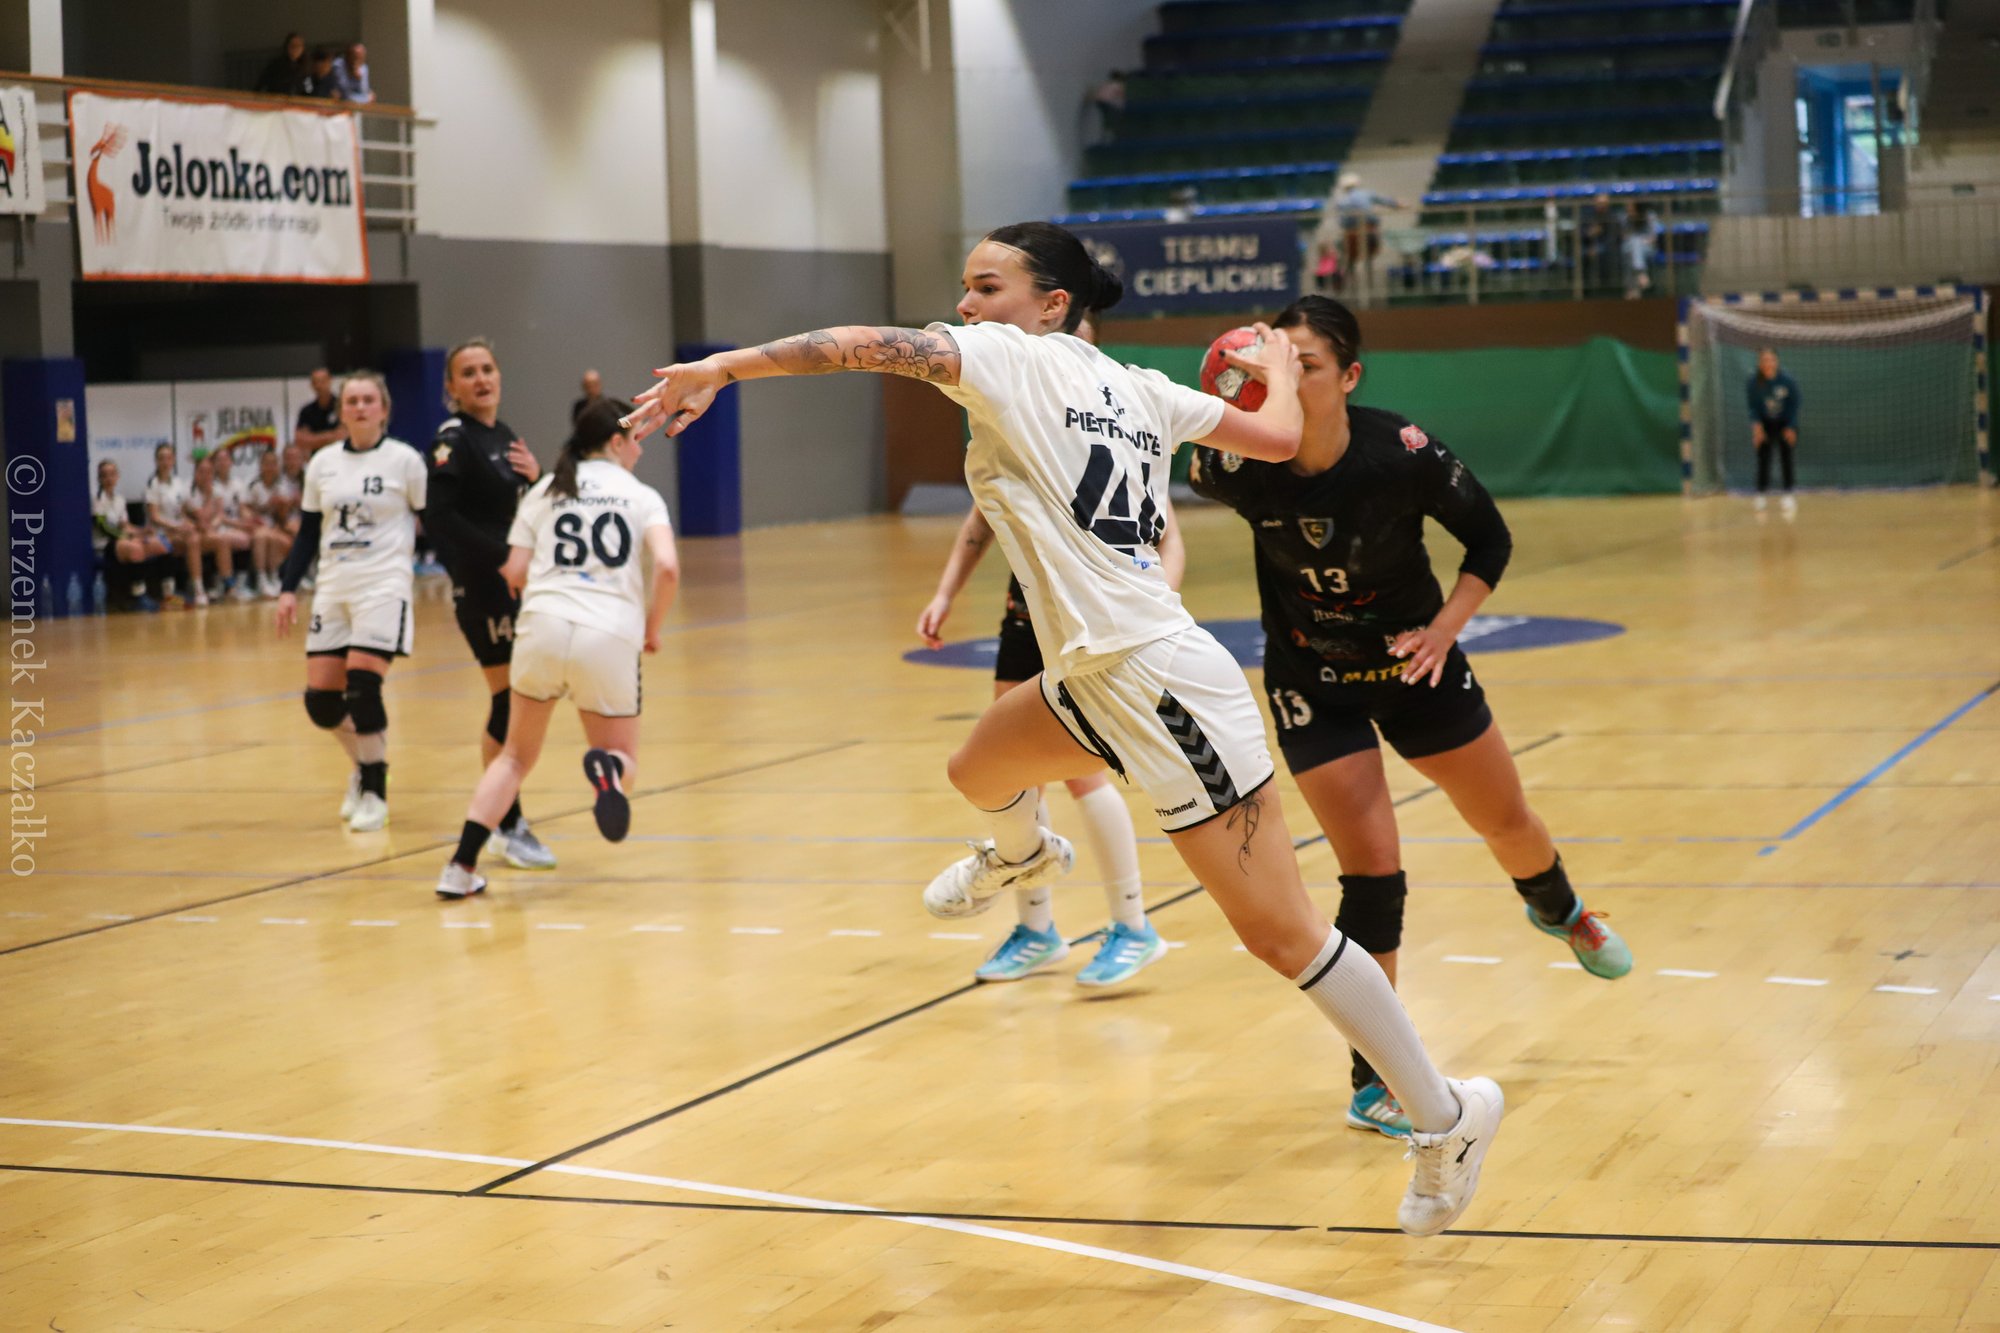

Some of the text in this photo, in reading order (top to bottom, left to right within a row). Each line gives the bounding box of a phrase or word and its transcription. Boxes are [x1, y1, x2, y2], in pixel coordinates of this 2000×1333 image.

[132, 140, 351, 206] Jelonka.com
[1133, 262, 1287, 297] CIEPLICKIE
[363, 476, 383, 495] 13
[554, 512, 632, 569] 80
[1300, 568, 1350, 594] 13
[309, 614, 322, 633] 3
[1272, 687, 1314, 730] 13
[1161, 797, 1198, 817] hummel
